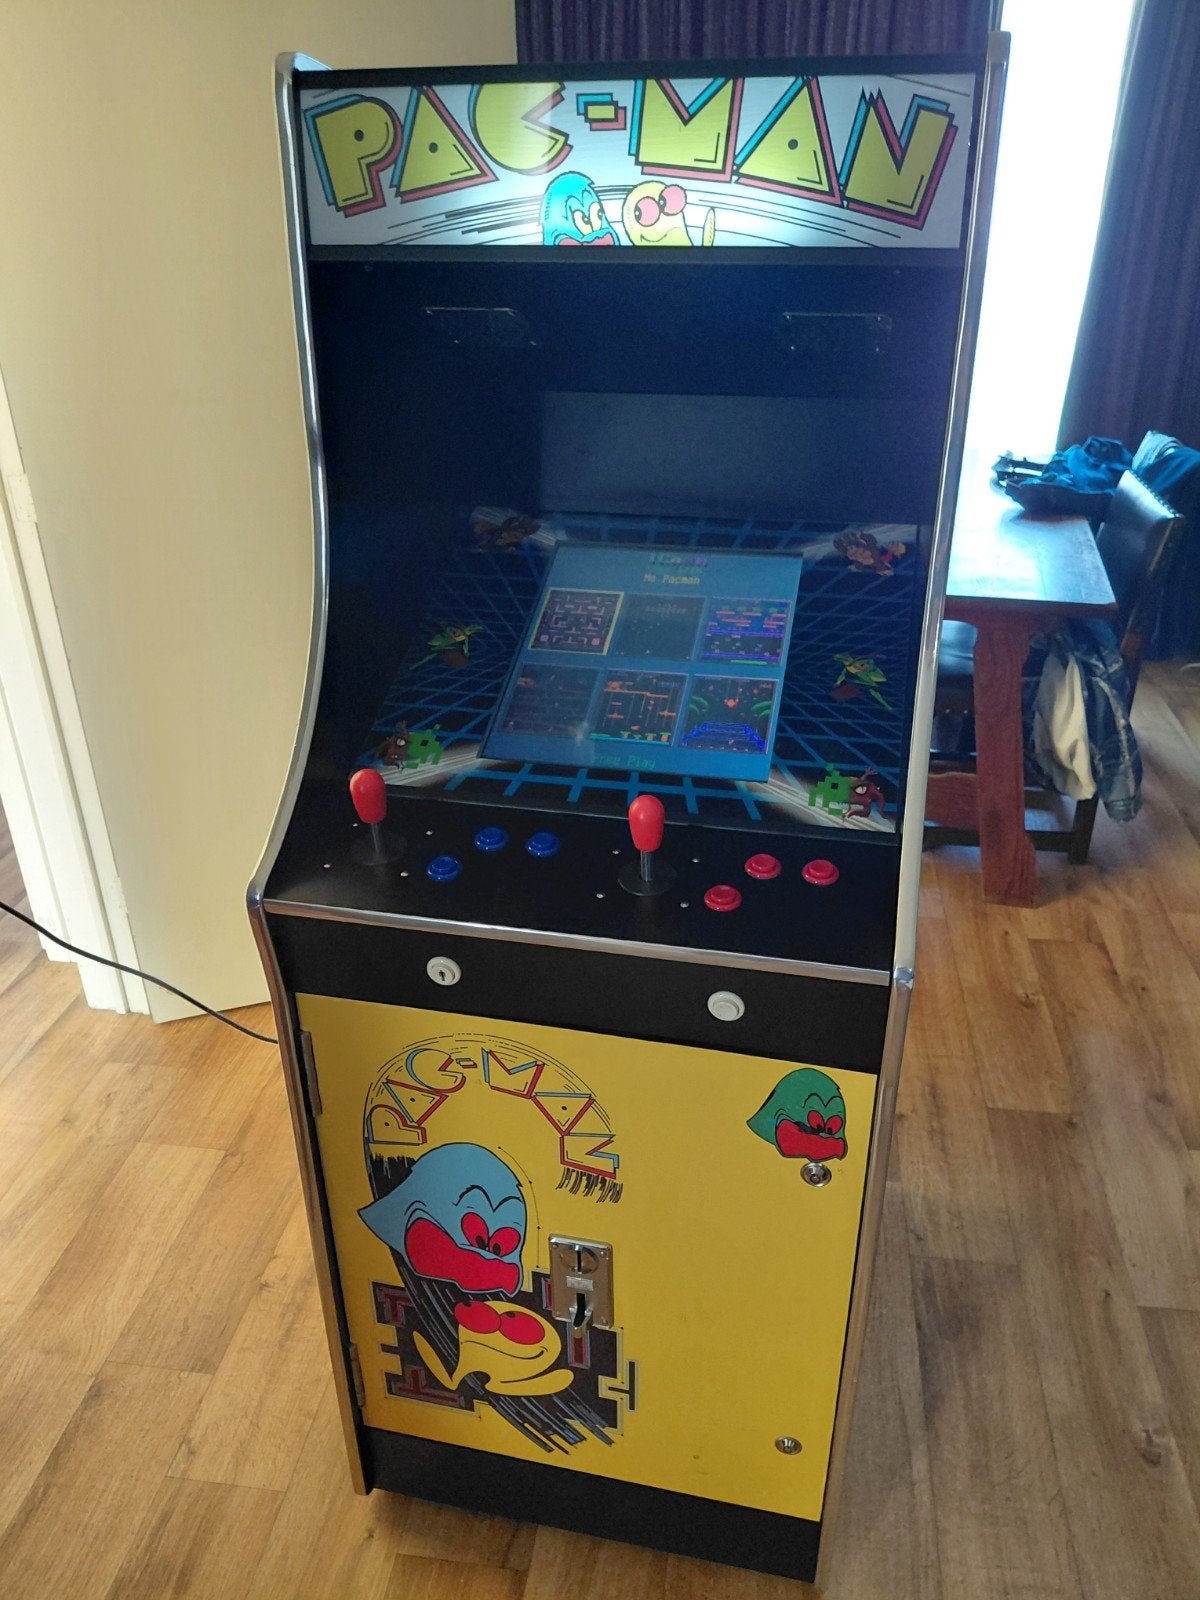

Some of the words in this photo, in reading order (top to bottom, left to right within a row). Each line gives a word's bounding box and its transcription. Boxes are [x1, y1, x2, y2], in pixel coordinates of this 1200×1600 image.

[303, 76, 957, 229] PAC-MAN
[627, 756, 656, 770] Play
[366, 1047, 619, 1179] PAC-MAN
